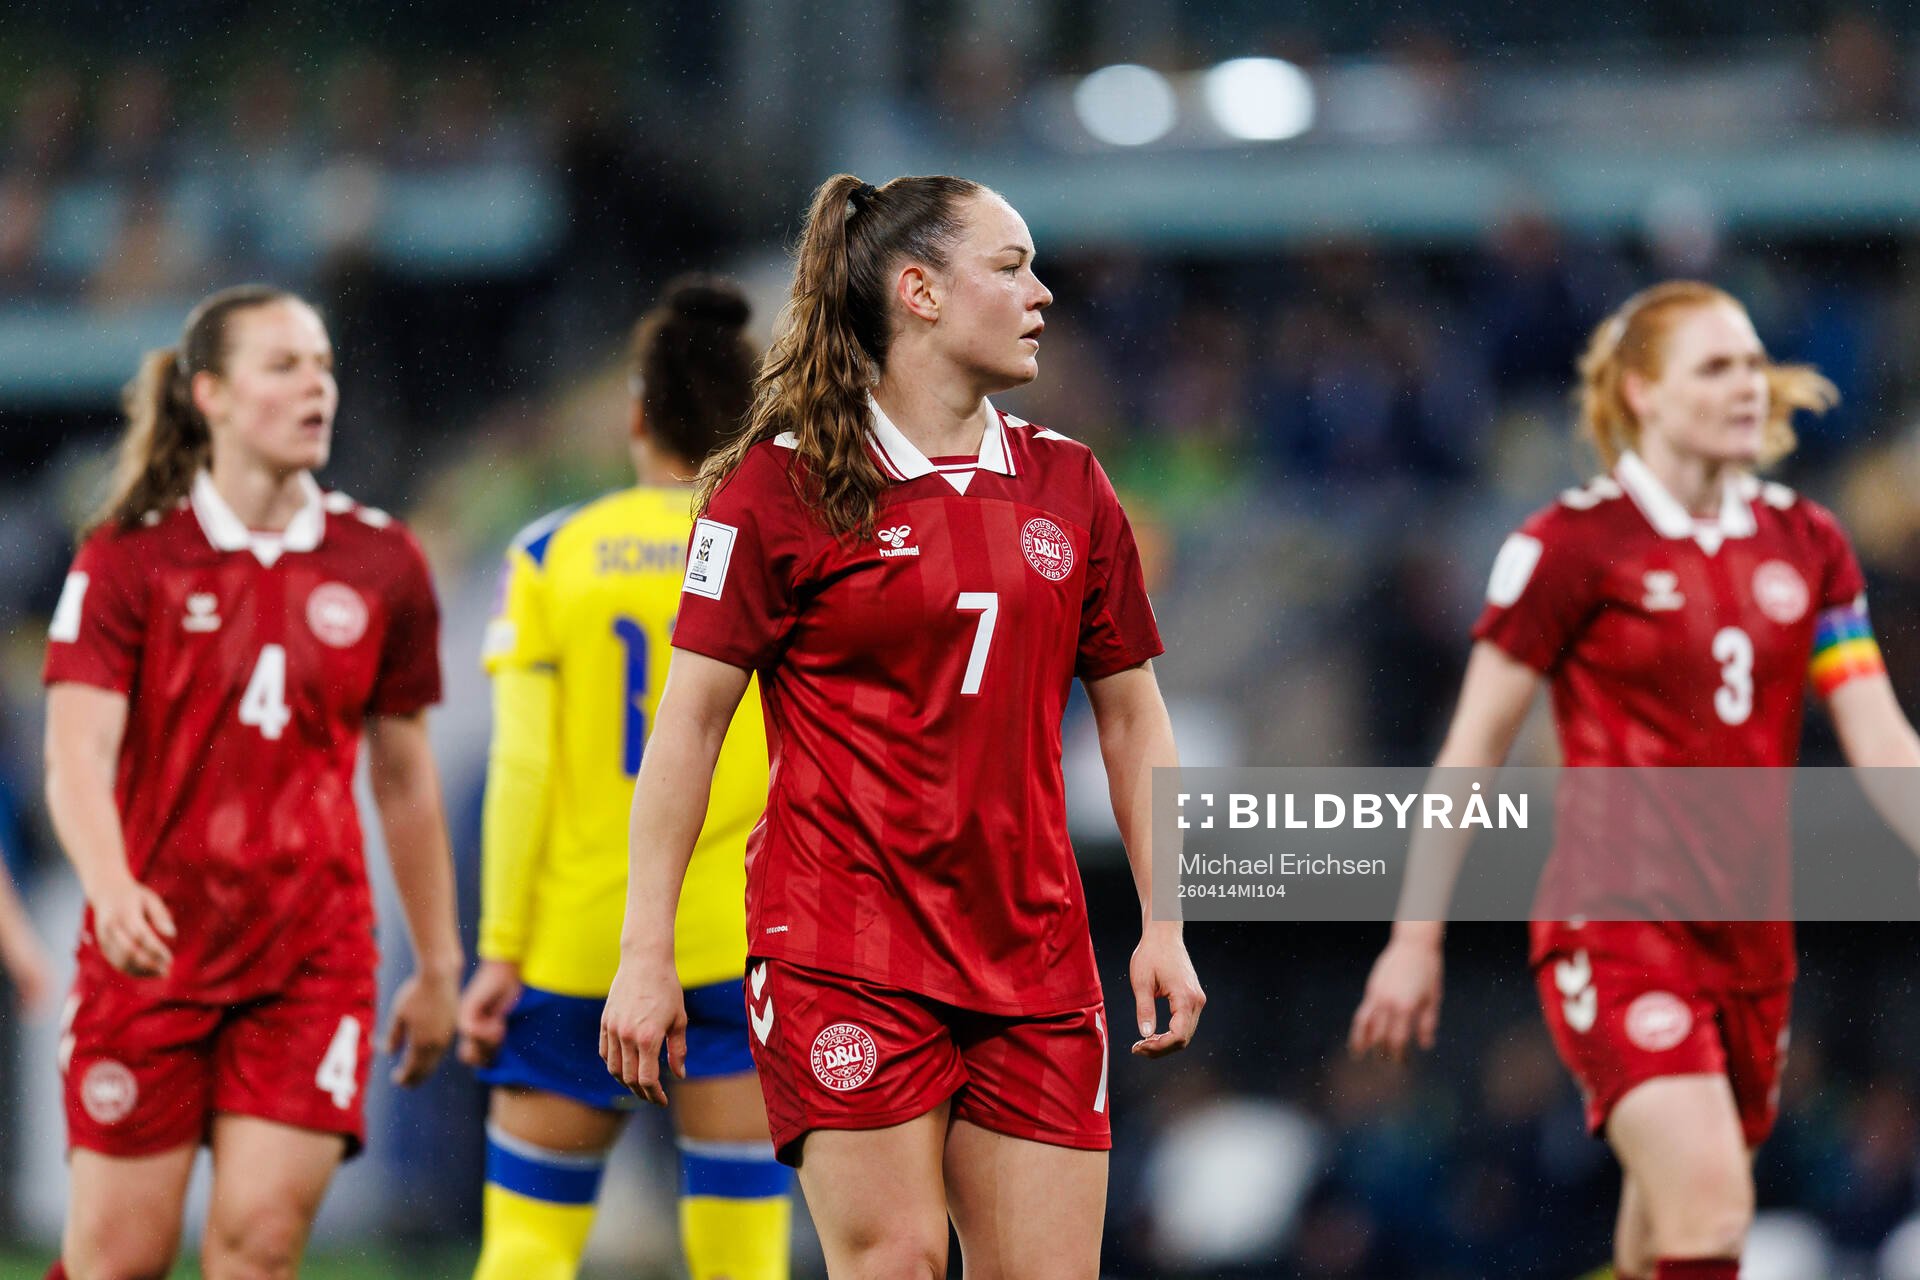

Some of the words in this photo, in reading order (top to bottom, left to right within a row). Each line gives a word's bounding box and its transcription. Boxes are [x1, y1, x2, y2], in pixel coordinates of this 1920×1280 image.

[879, 545, 920, 557] hummel
[1025, 531, 1041, 568] DANSK
[1033, 537, 1062, 560] DBU
[1061, 542, 1071, 574] UNION
[1042, 567, 1061, 579] 1889
[956, 592, 998, 694] 7
[239, 643, 292, 740] 4
[1712, 626, 1754, 726] 3
[315, 1015, 360, 1110] 4
[813, 1050, 834, 1085] DANSK
[823, 1043, 863, 1069] DBU
[862, 1038, 874, 1074] UNION
[837, 1075, 863, 1088] 1889
